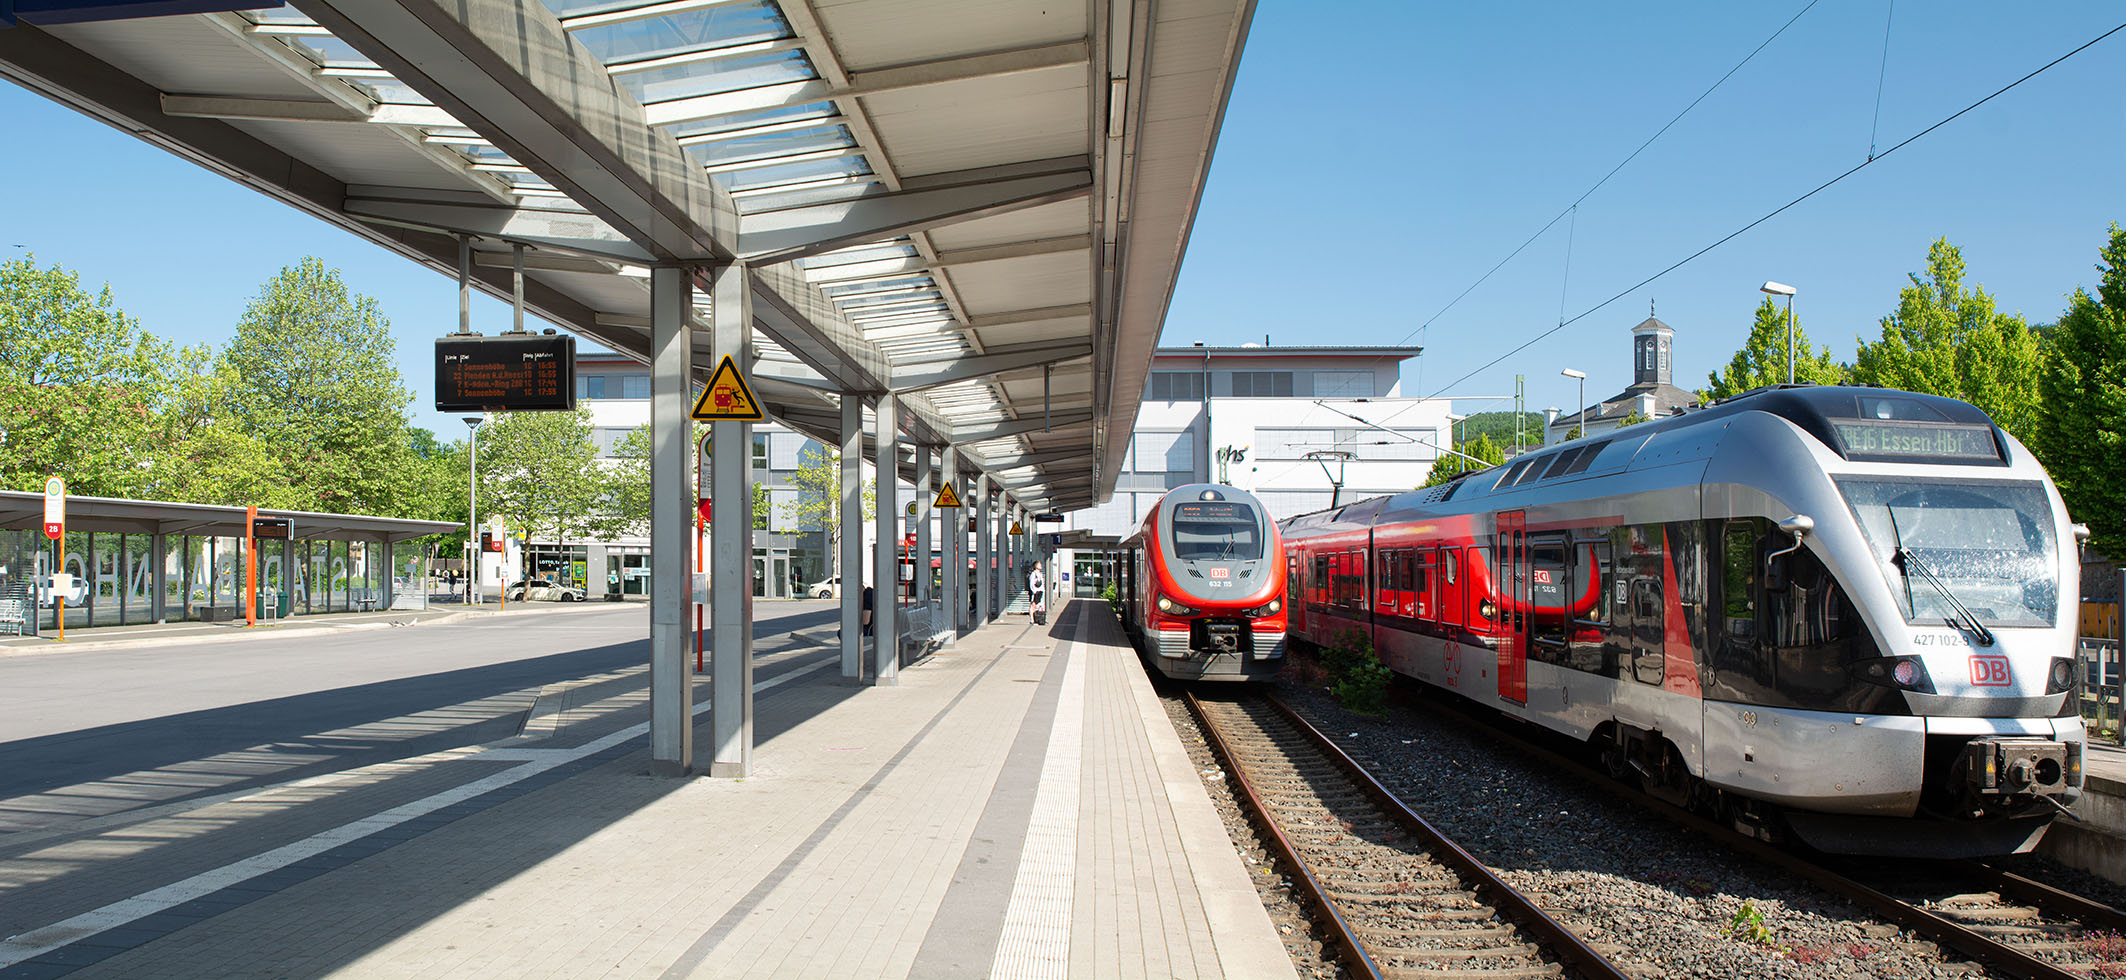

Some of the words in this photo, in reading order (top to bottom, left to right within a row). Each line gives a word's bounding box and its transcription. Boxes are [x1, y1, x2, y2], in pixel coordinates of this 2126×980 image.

[1881, 428, 1931, 452] Essen
[1936, 430, 1963, 453] Hbf
[1212, 569, 1228, 577] DB
[1617, 584, 1626, 601] DB
[1914, 634, 1935, 646] 427
[1939, 634, 1970, 646] 102-9
[1972, 660, 2007, 682] DB
